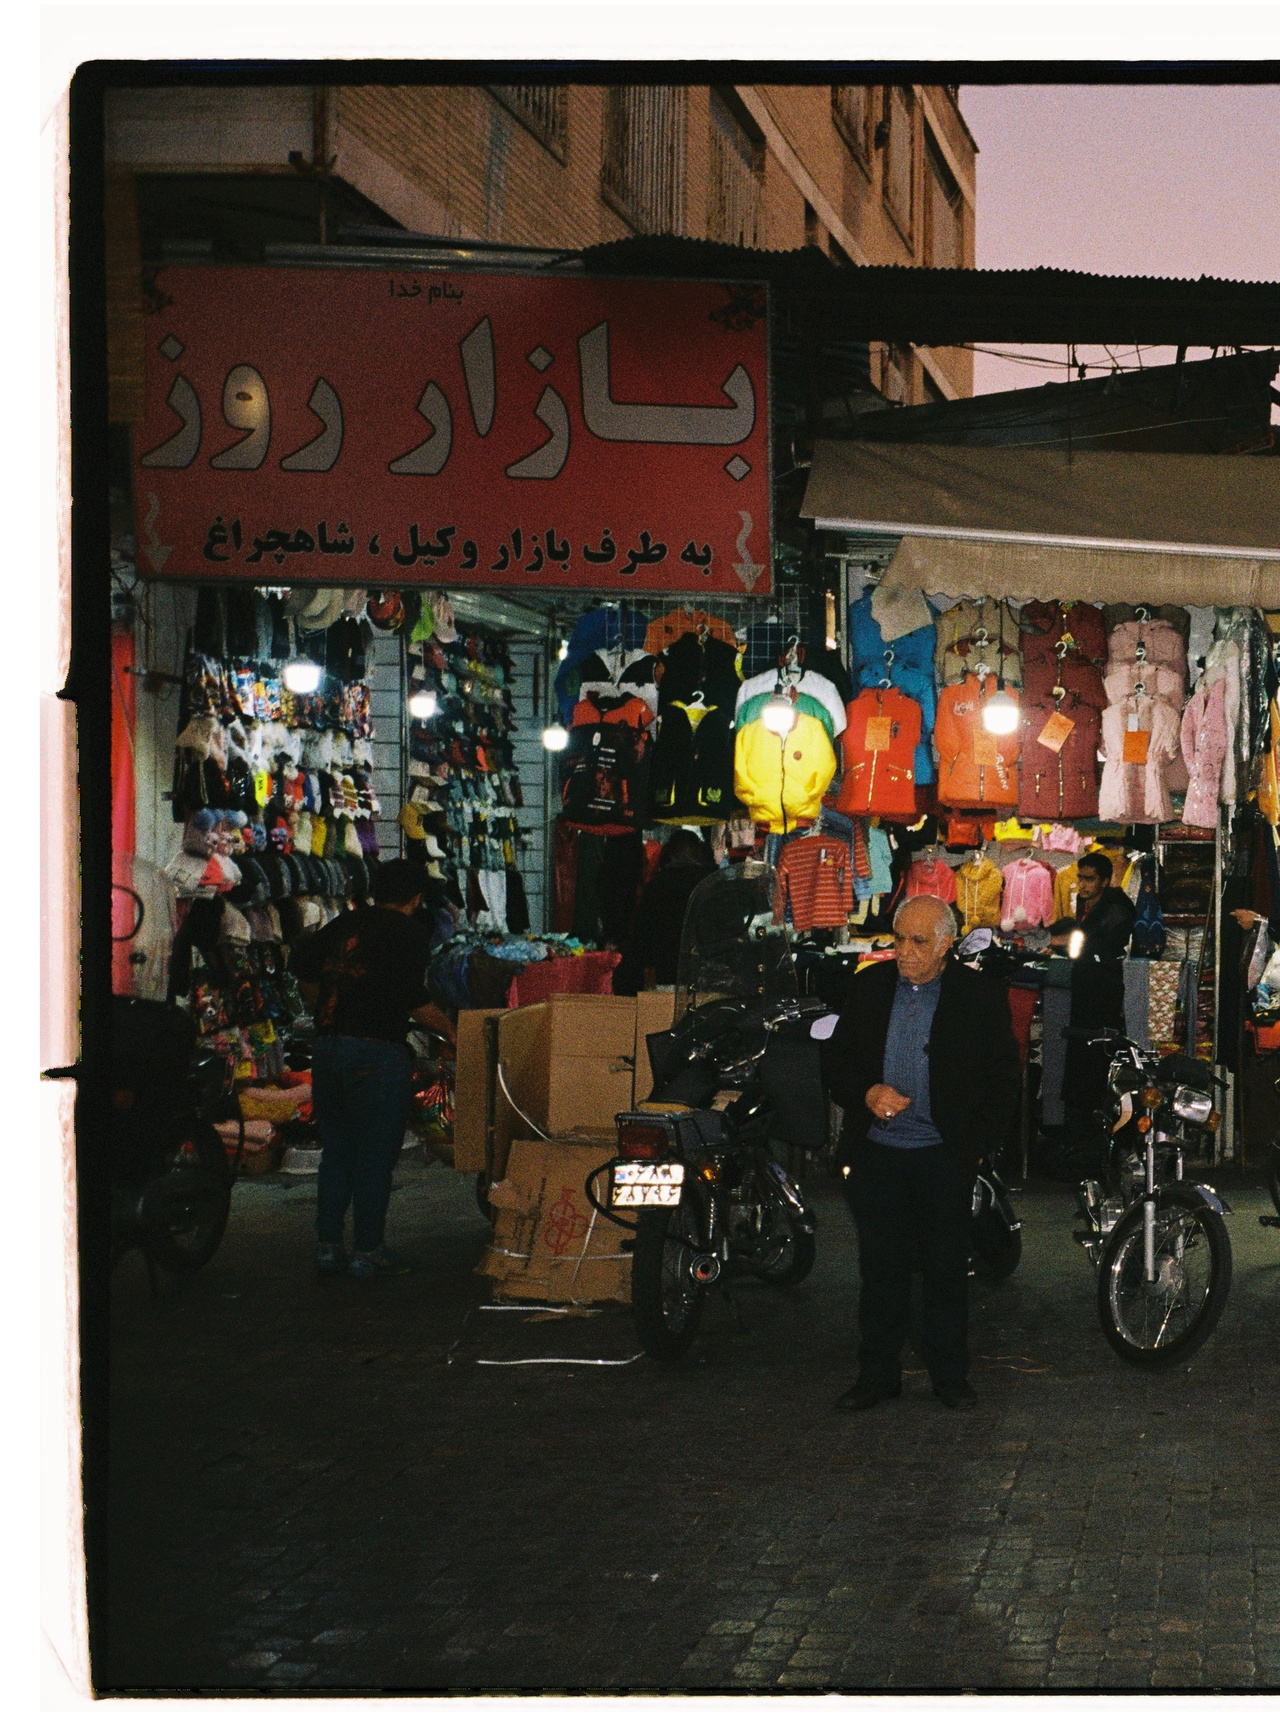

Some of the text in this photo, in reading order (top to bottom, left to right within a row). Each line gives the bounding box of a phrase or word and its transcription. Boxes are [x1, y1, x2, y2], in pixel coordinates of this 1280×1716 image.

[389, 278, 464, 305] بنام خدا
[140, 314, 757, 482] بازار روز
[203, 515, 355, 566] شاهچراغ
[393, 523, 478, 570] وکیل
[490, 526, 571, 572] بازار
[582, 528, 668, 575] طرف
[680, 540, 712, 576] به
